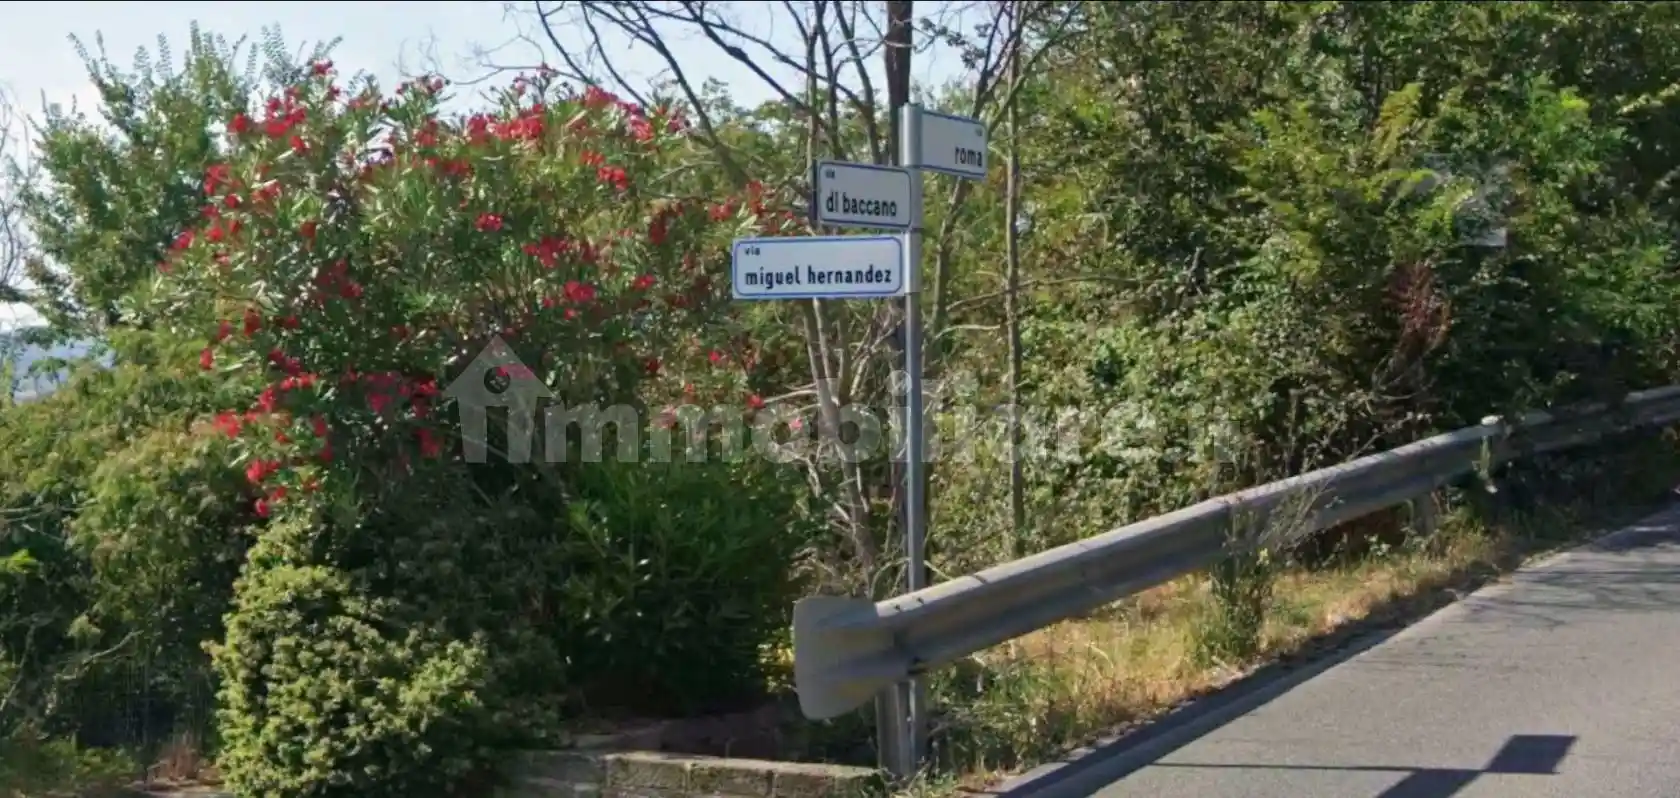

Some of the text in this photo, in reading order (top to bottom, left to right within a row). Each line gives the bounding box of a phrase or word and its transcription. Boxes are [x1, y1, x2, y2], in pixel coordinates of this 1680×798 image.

[954, 146, 983, 168] roma
[826, 191, 897, 217] di baccano
[744, 246, 761, 256] via
[745, 264, 892, 290] miguel hernandez
